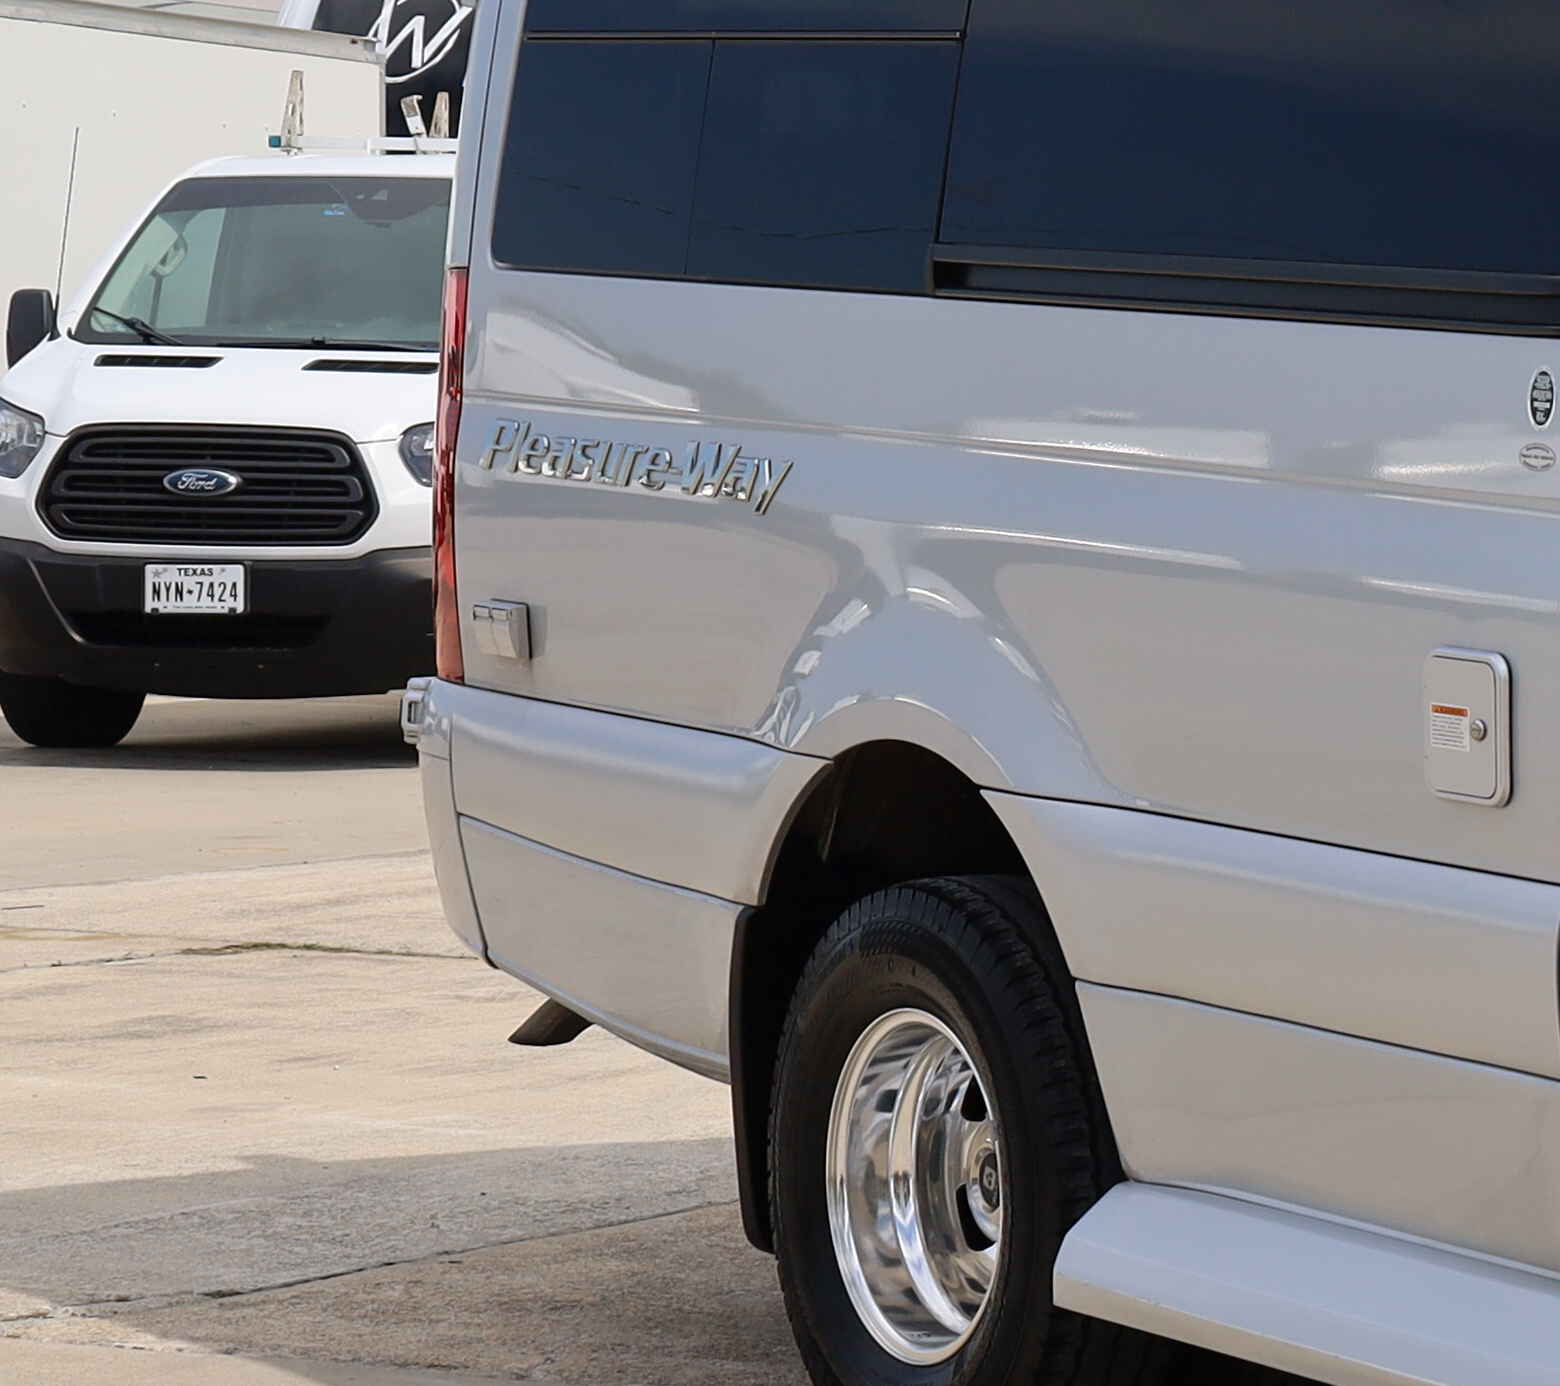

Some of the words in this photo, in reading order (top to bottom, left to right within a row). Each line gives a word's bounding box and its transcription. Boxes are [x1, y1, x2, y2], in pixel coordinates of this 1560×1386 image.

[479, 418, 793, 515] Pleasure-Way
[177, 472, 218, 491] Ford
[177, 567, 214, 578] TEXAS
